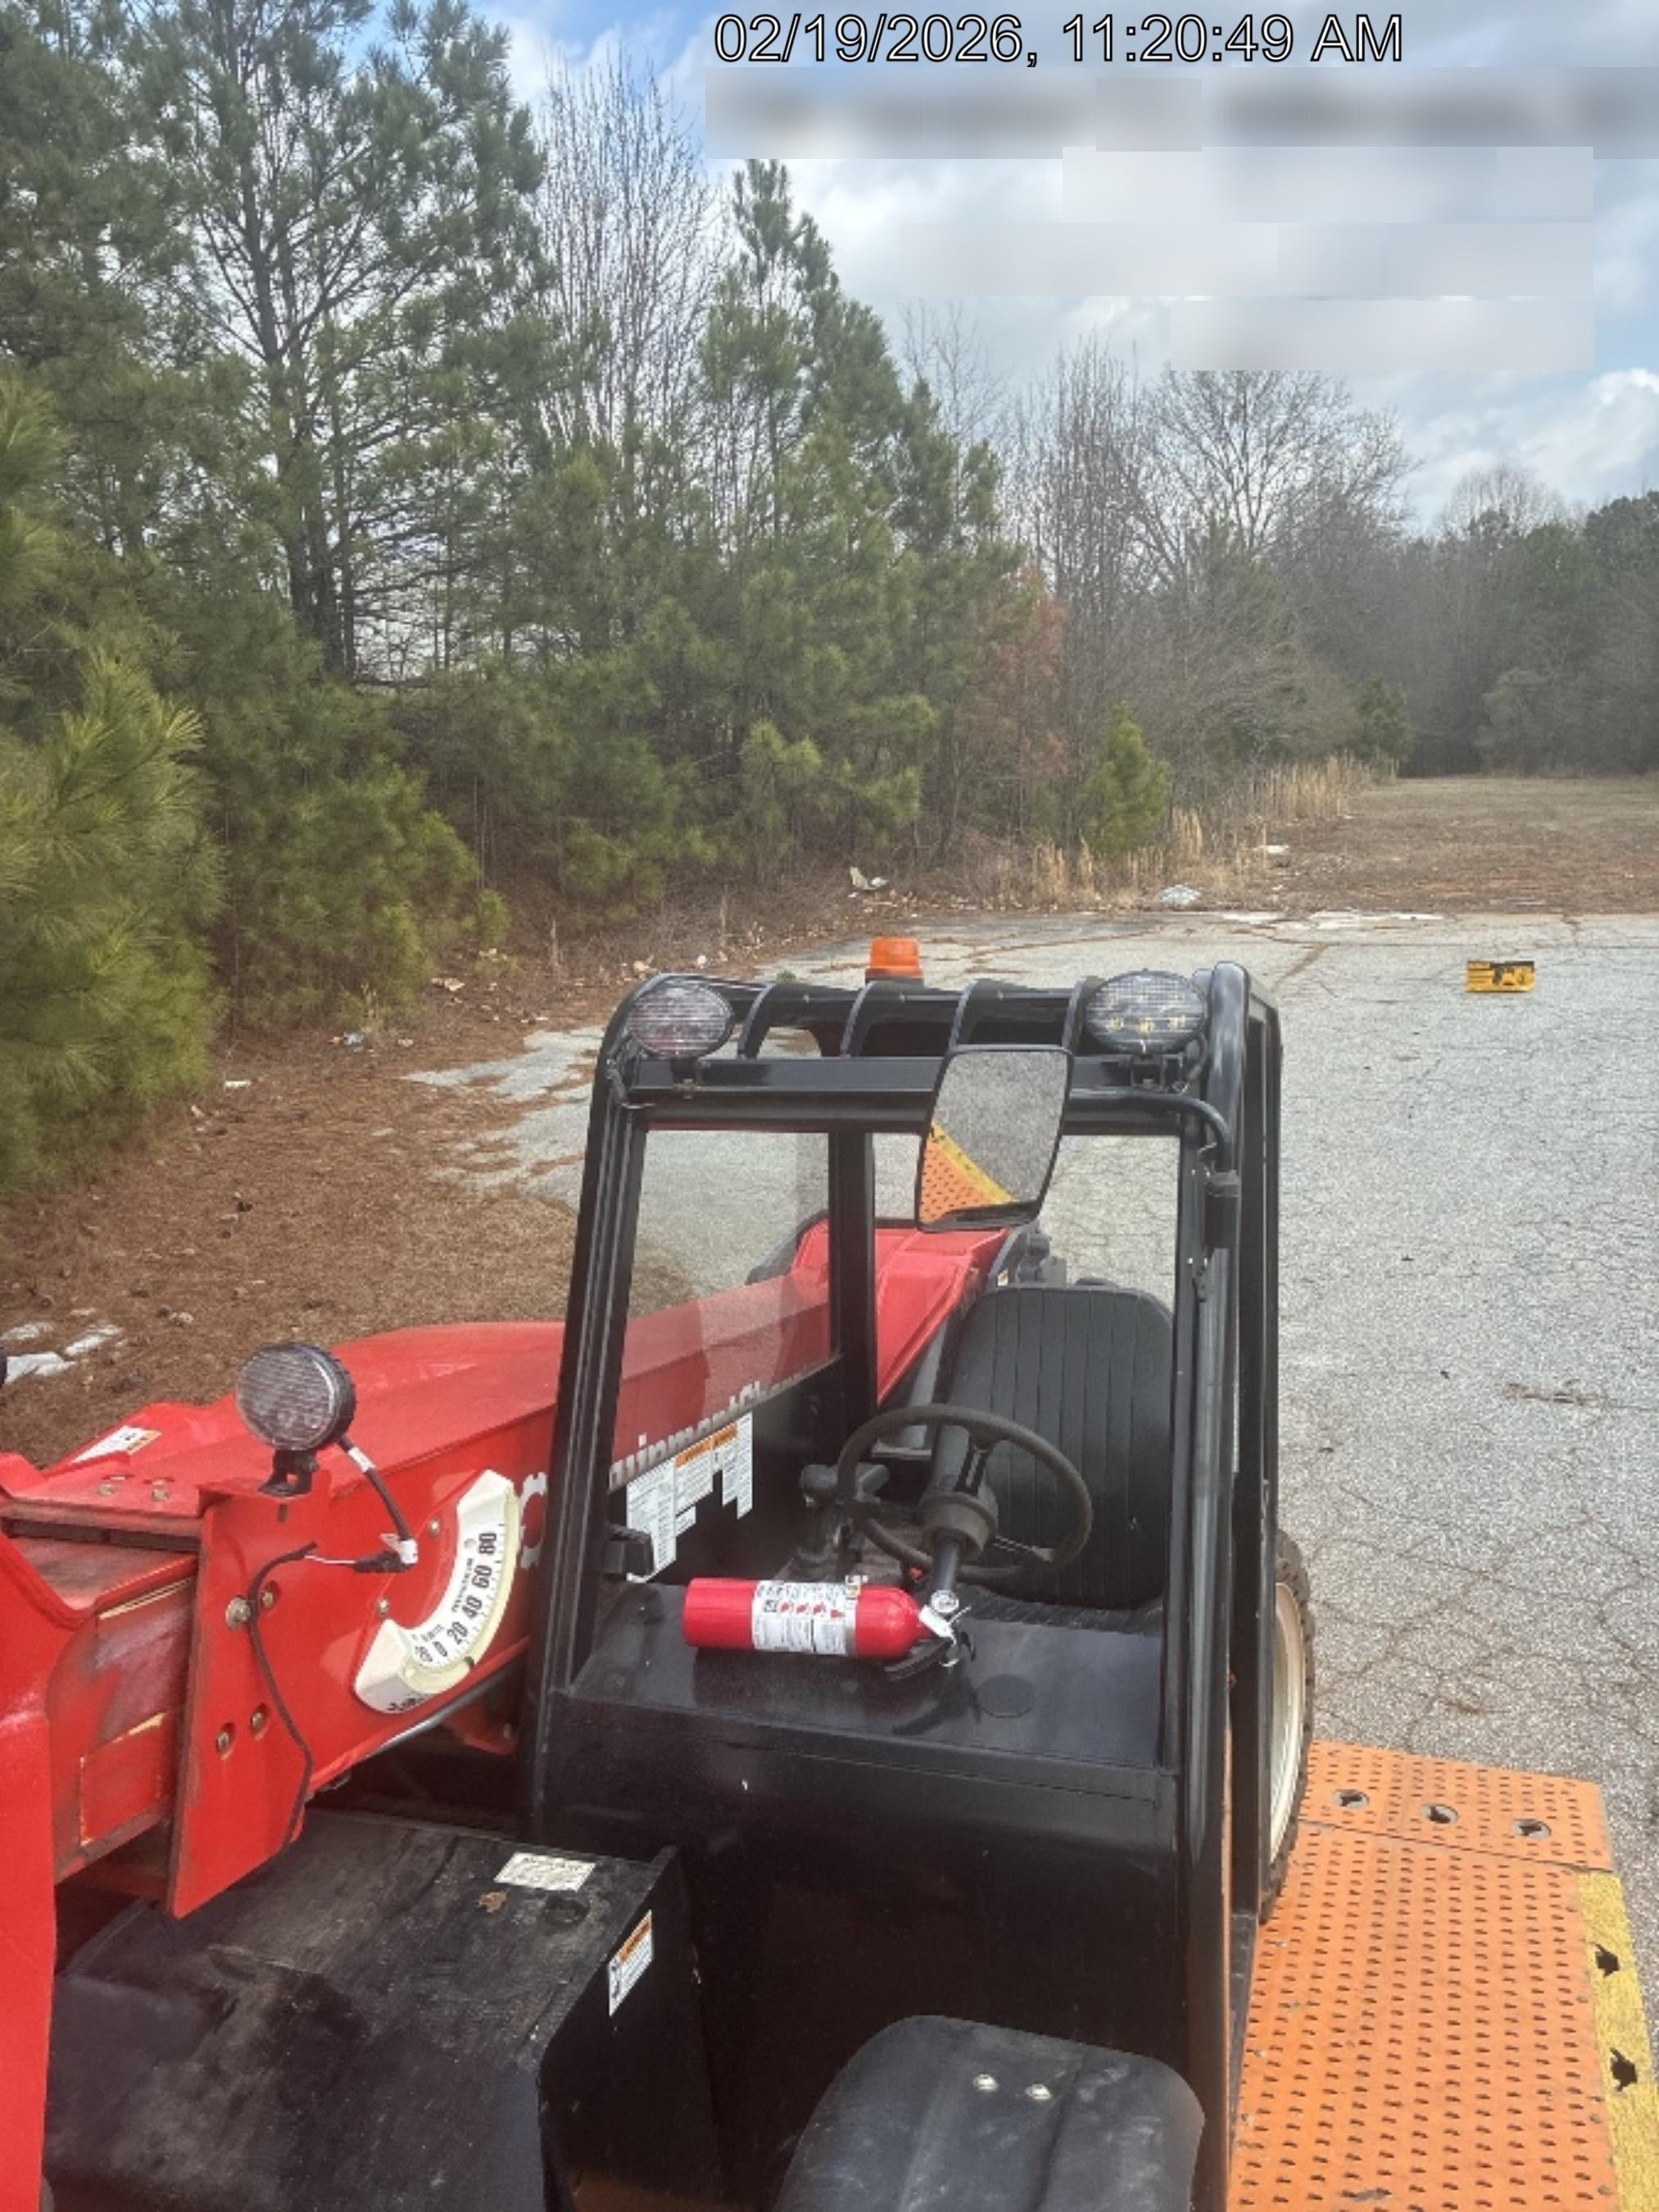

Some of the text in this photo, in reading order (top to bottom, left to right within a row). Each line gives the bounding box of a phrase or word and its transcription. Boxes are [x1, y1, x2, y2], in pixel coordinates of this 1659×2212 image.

[478, 1533, 496, 1555] 80
[472, 1565, 492, 1588] 60
[461, 1594, 482, 1619] 40
[446, 1621, 467, 1645] 20
